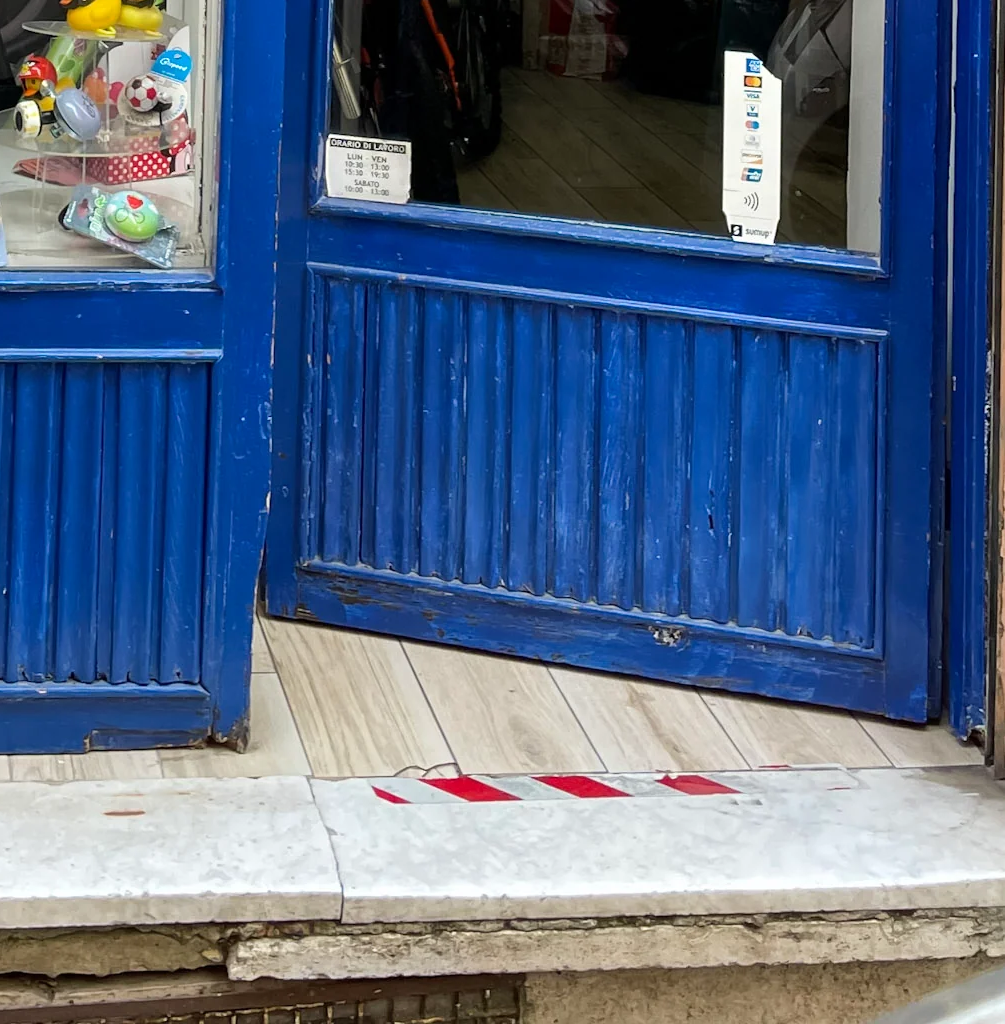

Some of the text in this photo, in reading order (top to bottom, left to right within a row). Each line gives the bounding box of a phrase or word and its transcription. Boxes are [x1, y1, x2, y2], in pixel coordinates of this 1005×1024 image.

[331, 138, 405, 153] ORARIO DI LAVORO
[371, 163, 390, 171] 13:00
[344, 168, 390, 179] 15:30 19:30
[354, 179, 380, 188] SABATO
[745, 228, 770, 239] sumup
